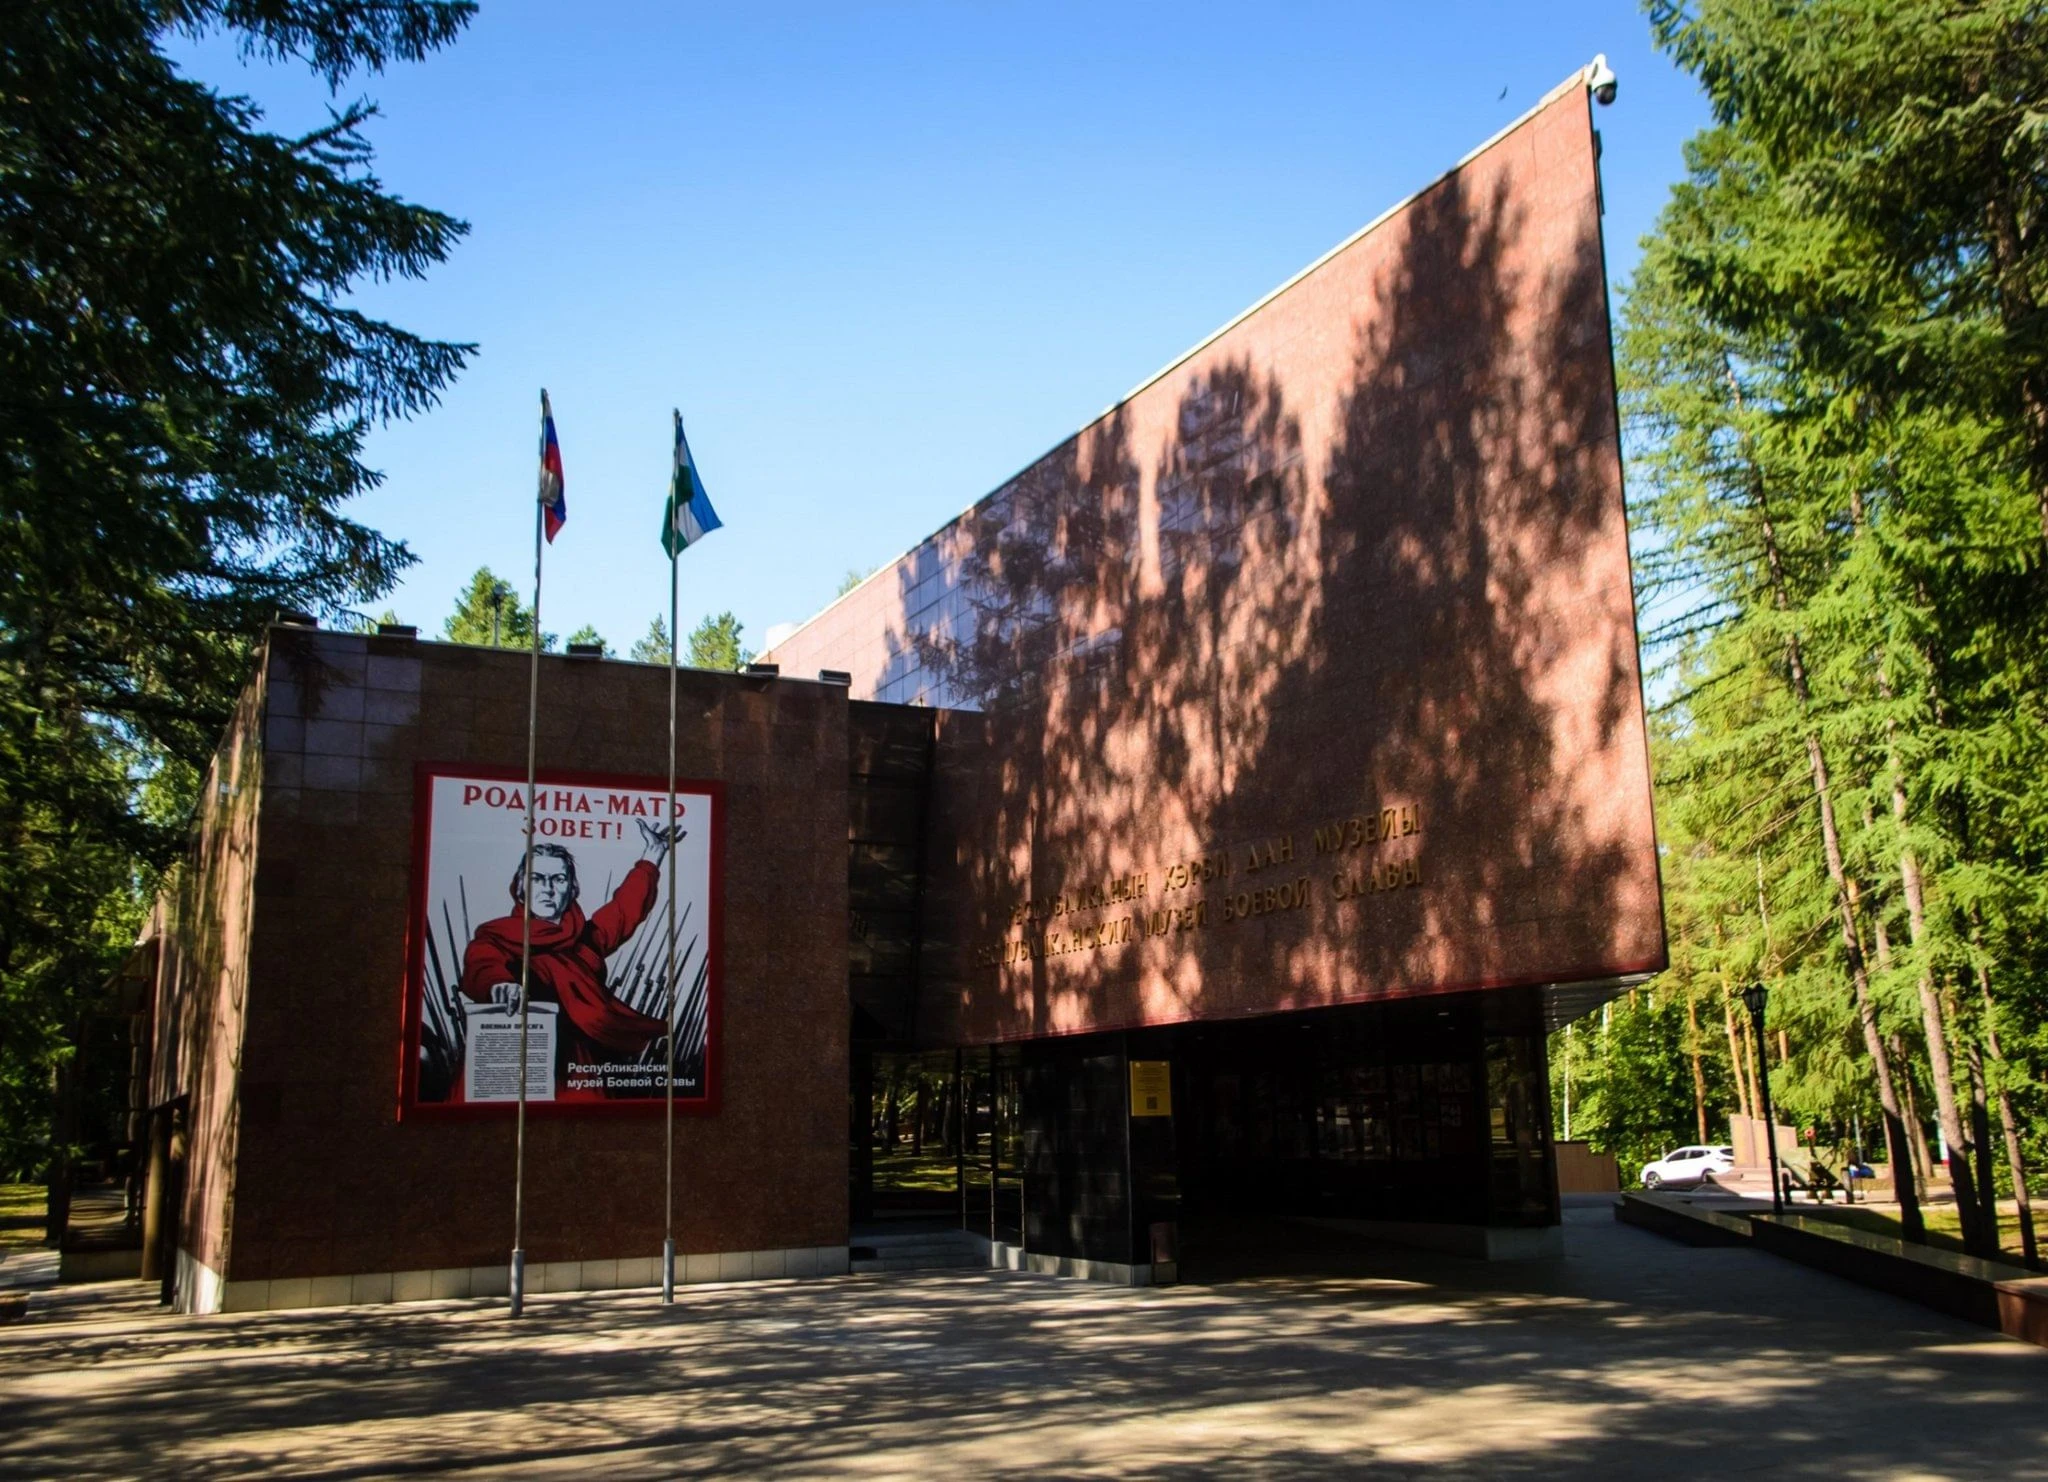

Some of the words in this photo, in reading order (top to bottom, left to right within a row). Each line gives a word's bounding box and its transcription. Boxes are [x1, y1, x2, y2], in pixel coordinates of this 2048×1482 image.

[463, 785, 685, 819] РОДИНА-МАТЬ
[521, 816, 622, 839] ЗОВЕТ!
[1246, 834, 1294, 875] ДАН
[1314, 803, 1420, 853] МУЗЕЙЫ
[1144, 899, 1208, 938] МУЗЕЙ
[1223, 876, 1311, 921] БОЕВОЙ
[1332, 856, 1424, 901] СЛАВЫ
[567, 1062, 670, 1075] Республикански
[567, 1077, 603, 1091] музей
[607, 1076, 652, 1088] Боевой
